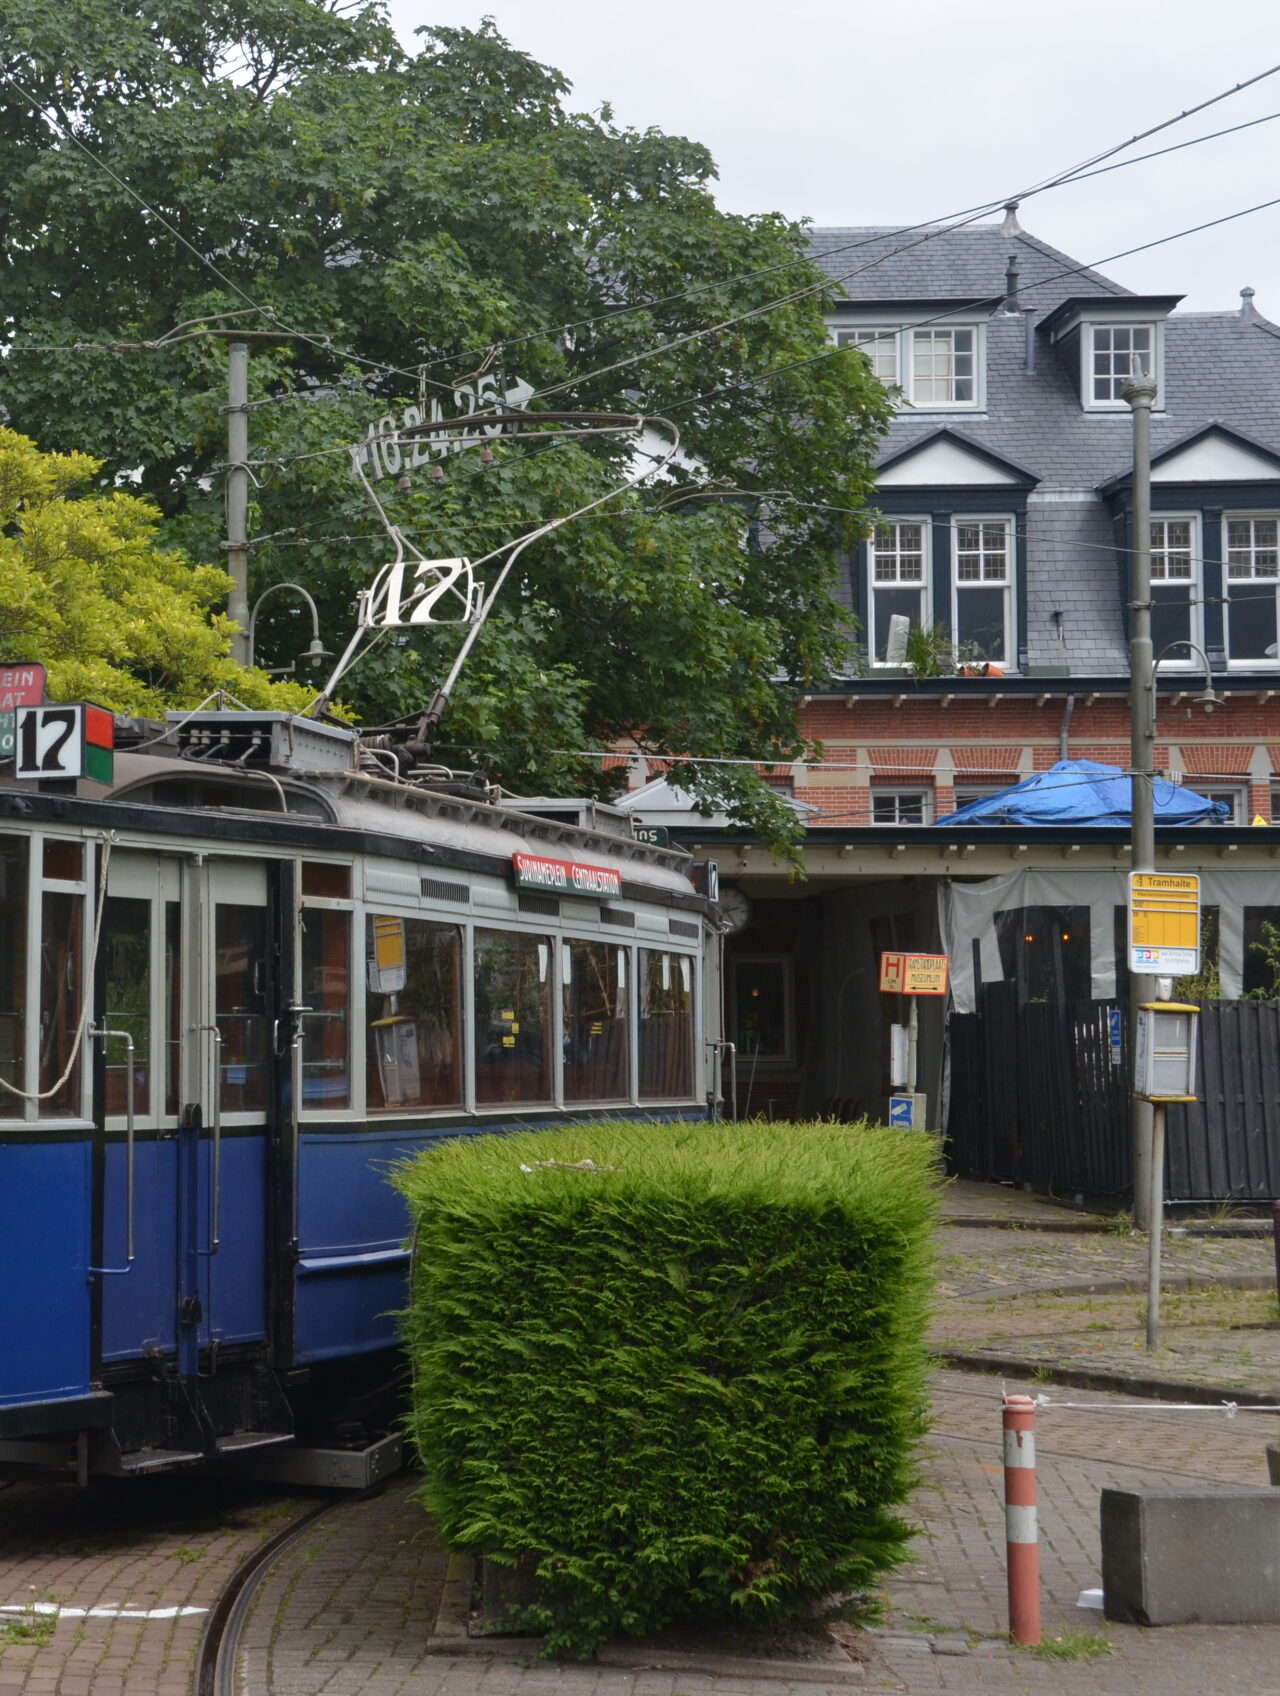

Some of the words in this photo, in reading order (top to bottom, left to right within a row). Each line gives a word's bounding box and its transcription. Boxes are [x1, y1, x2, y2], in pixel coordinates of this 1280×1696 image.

[381, 557, 462, 626] 17
[18, 708, 76, 772] 17
[517, 856, 567, 888] SURINAMEPLEIN
[572, 865, 620, 895] CENTRAALSTATION
[1148, 877, 1191, 888] Tramhalte
[885, 956, 901, 978] H
